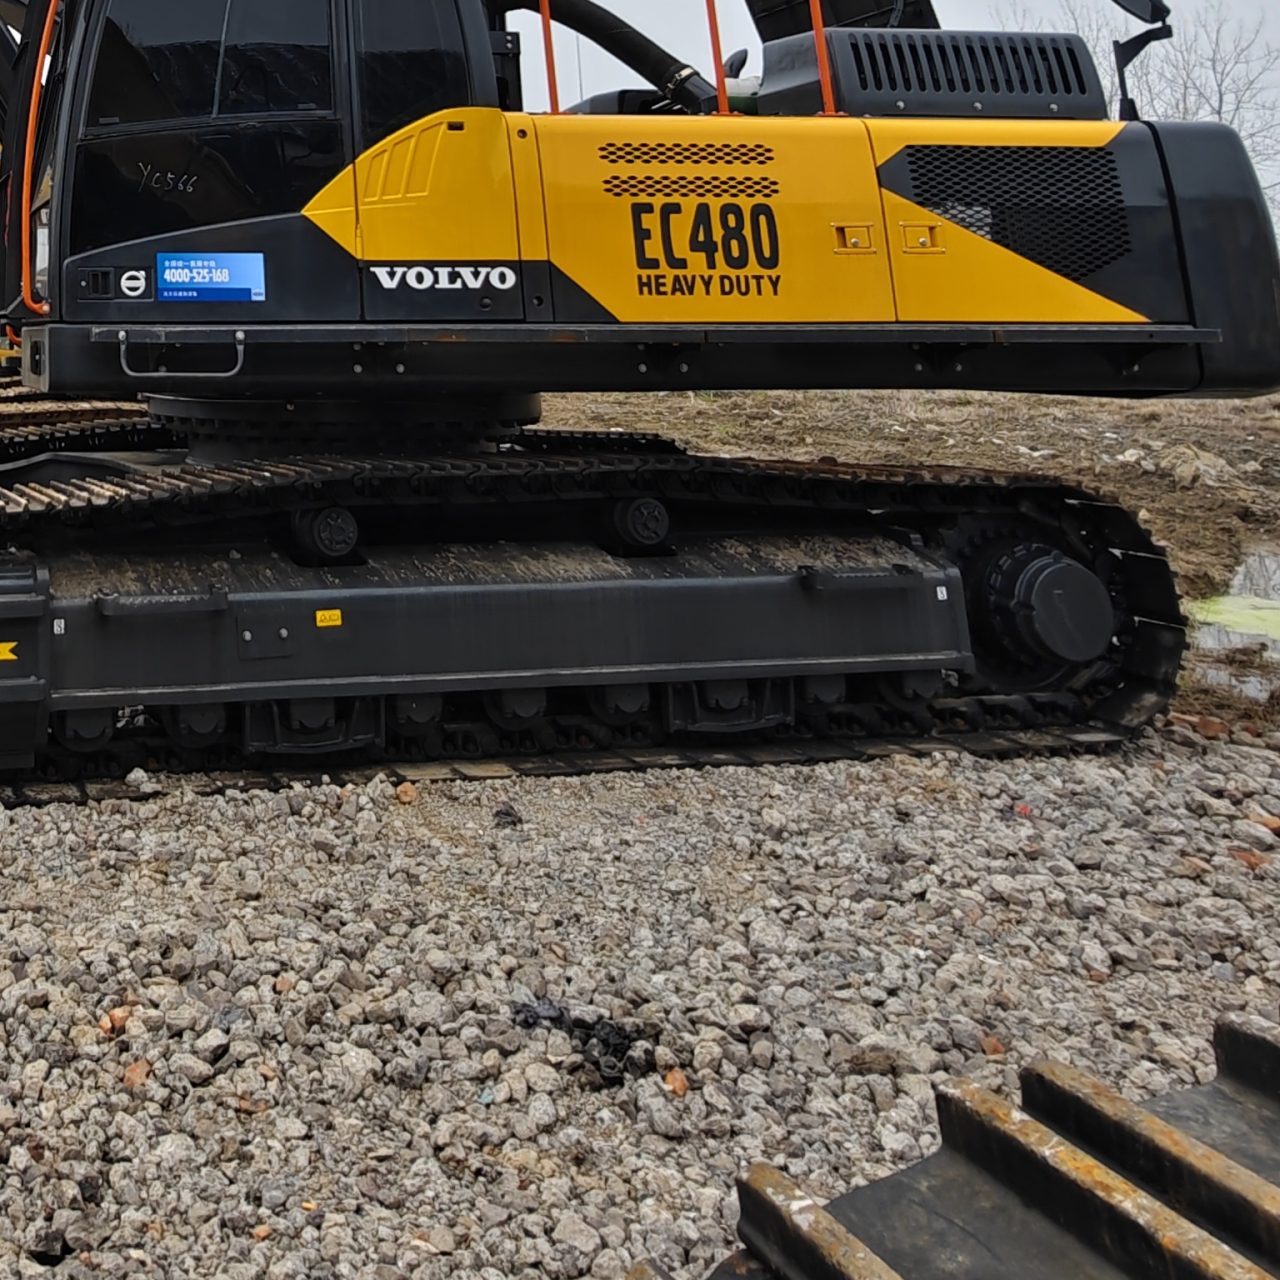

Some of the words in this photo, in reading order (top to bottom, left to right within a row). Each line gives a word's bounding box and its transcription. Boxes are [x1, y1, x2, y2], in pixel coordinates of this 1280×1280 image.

[630, 202, 780, 270] EC480
[369, 266, 517, 290] VOLVO
[637, 274, 713, 296] HEAVY
[719, 274, 781, 296] DUTY
